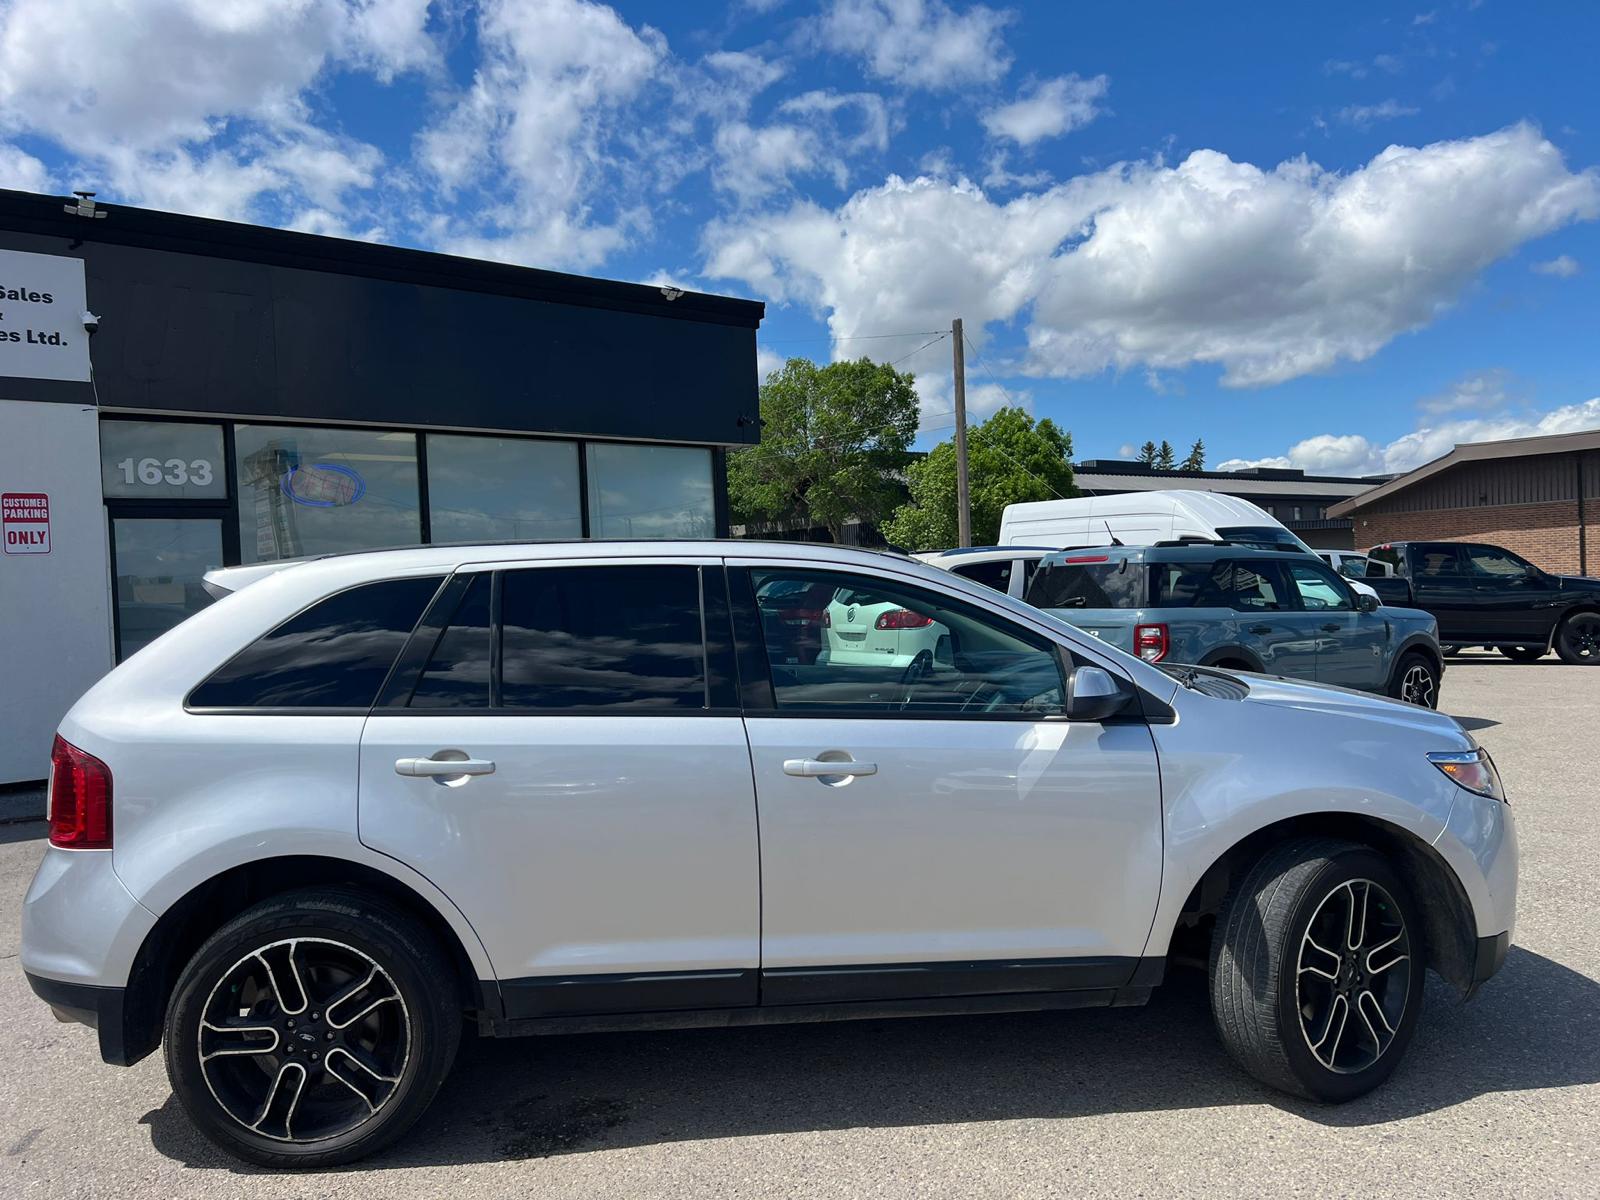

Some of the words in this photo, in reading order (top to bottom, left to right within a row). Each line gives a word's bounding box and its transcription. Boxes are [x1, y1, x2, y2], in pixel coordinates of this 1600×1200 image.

[27, 329, 68, 346] Ltd.
[118, 457, 213, 486] 1633
[3, 498, 47, 507] CUSTOMER
[4, 508, 48, 519] PARKING
[8, 531, 46, 545] ONLY
